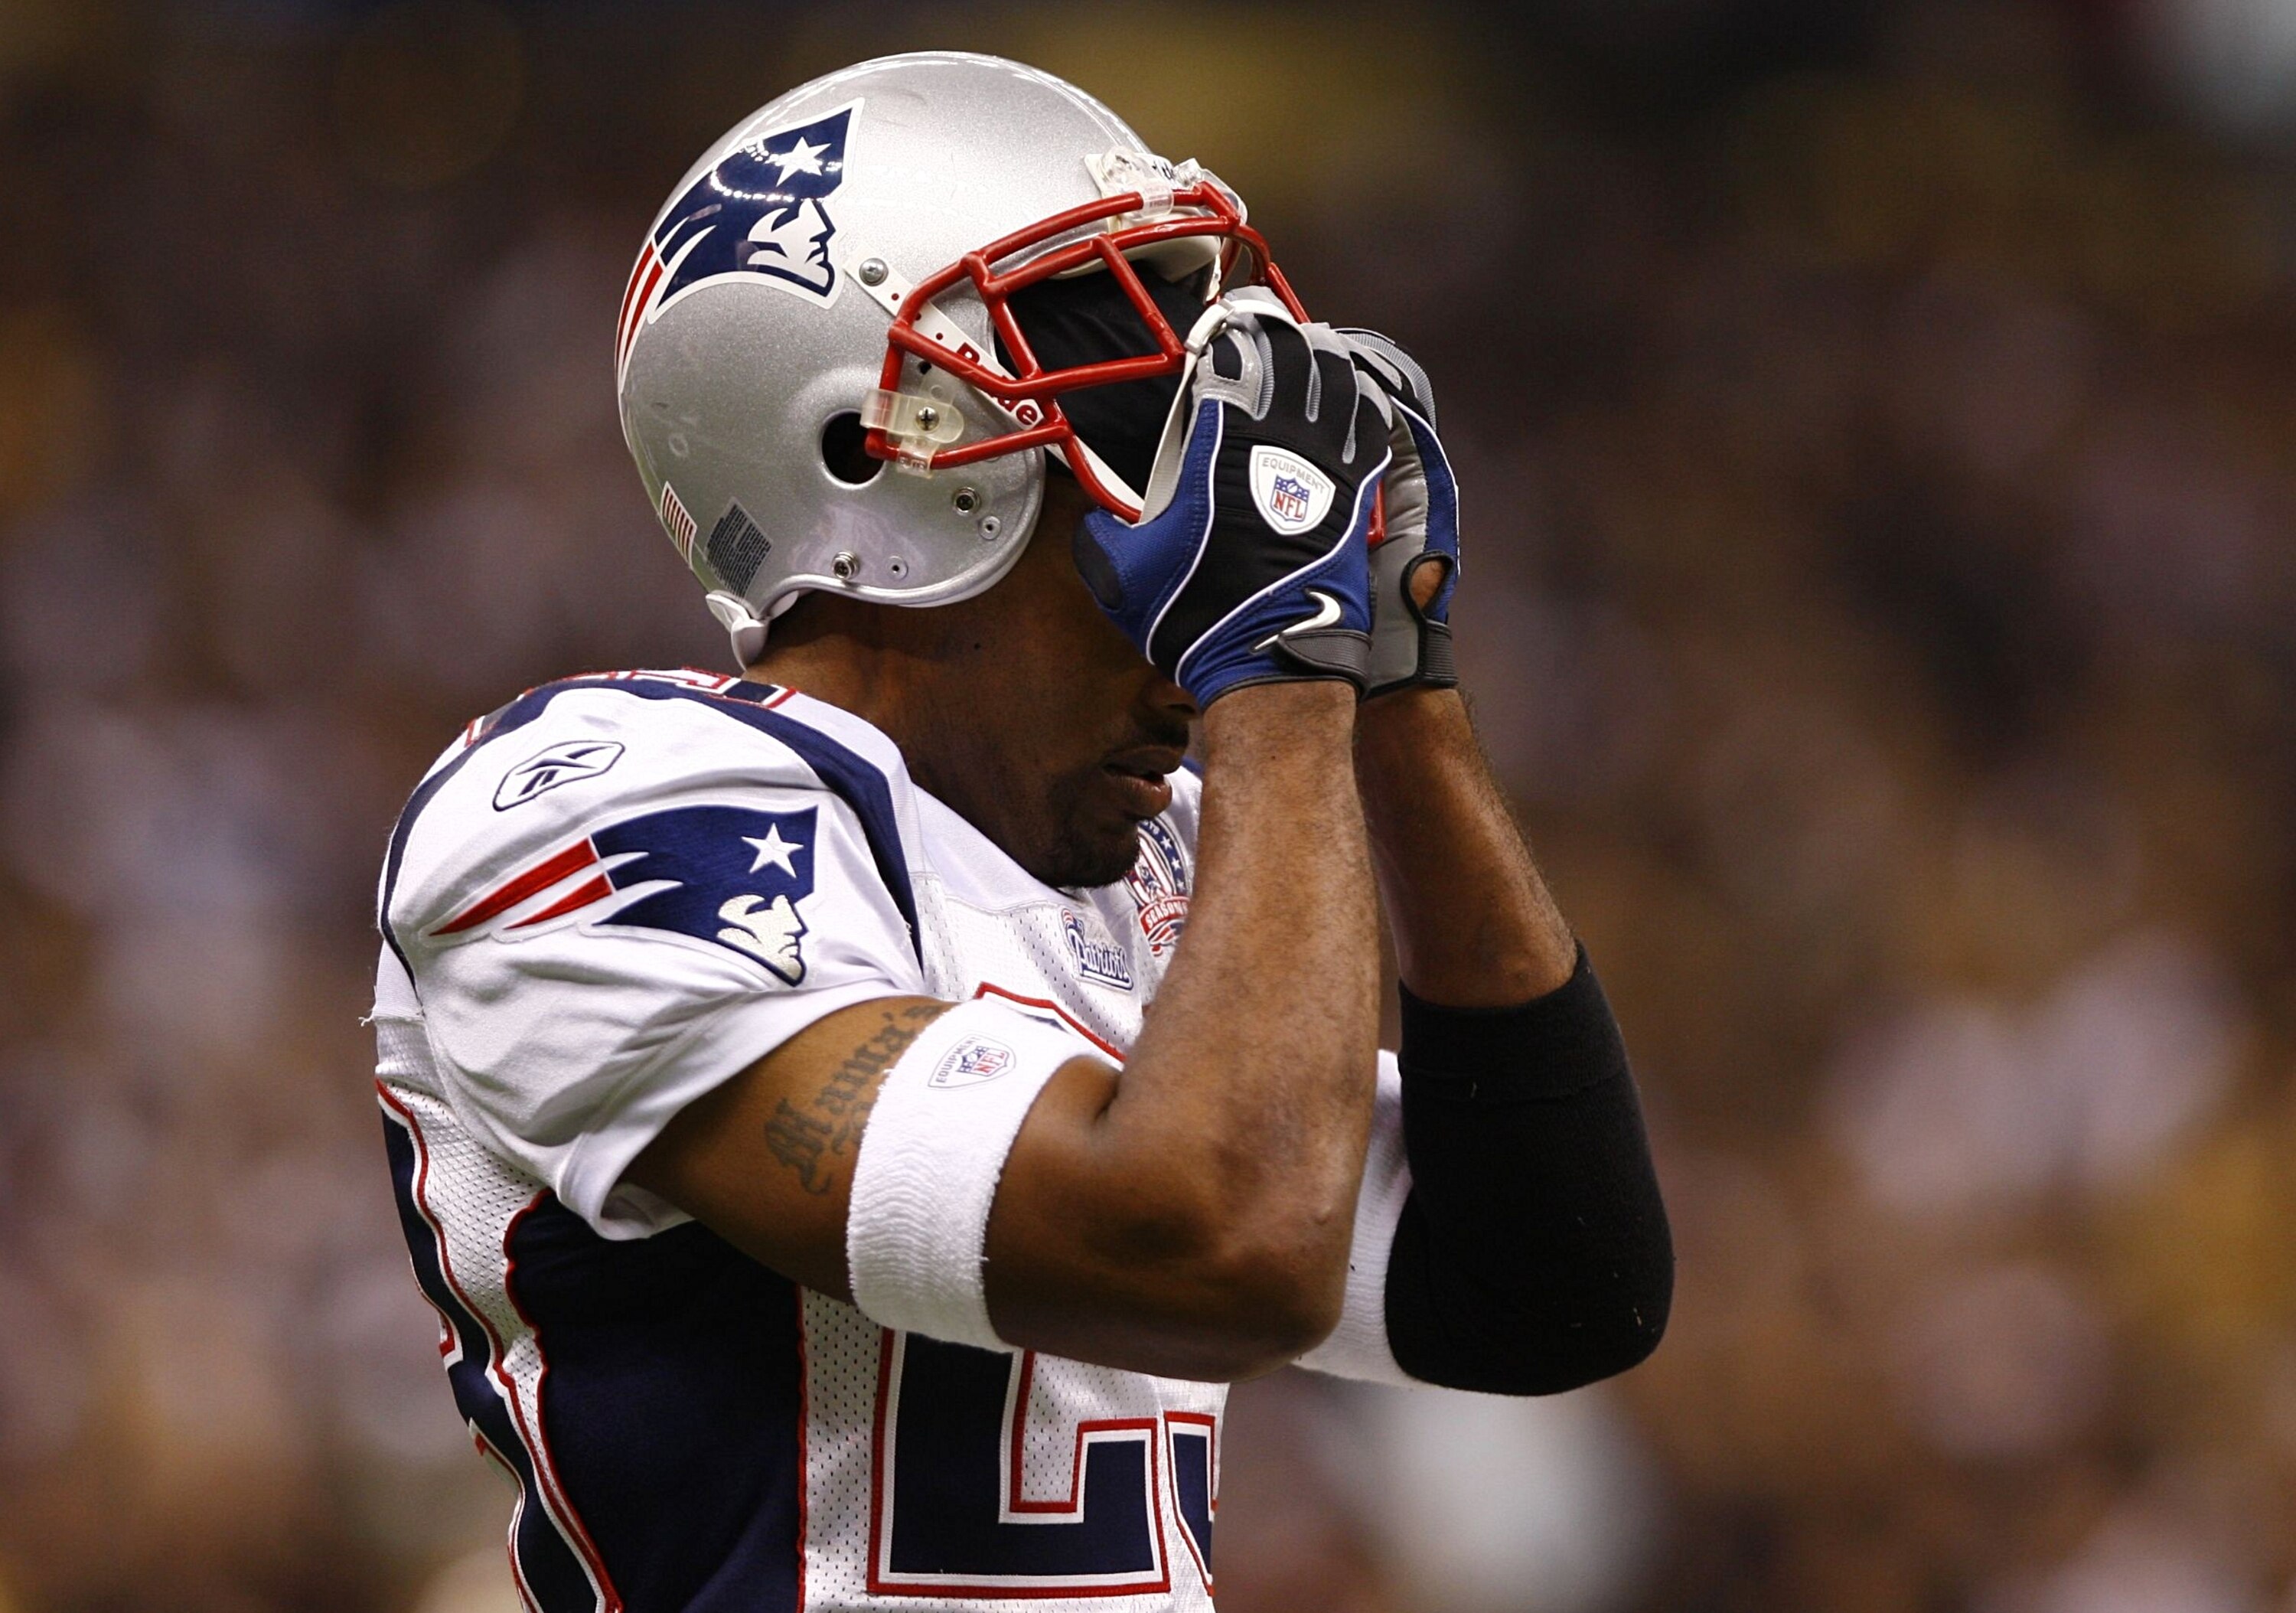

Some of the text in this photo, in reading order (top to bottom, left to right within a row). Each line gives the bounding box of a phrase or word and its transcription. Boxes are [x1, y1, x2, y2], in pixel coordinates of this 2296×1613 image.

[1262, 457, 1325, 494] EQUIPMENT
[1274, 491, 1303, 518] NFL
[1065, 926, 1133, 990] Patriots
[935, 1037, 981, 1083] EQUIPMENT
[973, 1052, 1005, 1073] NFL
